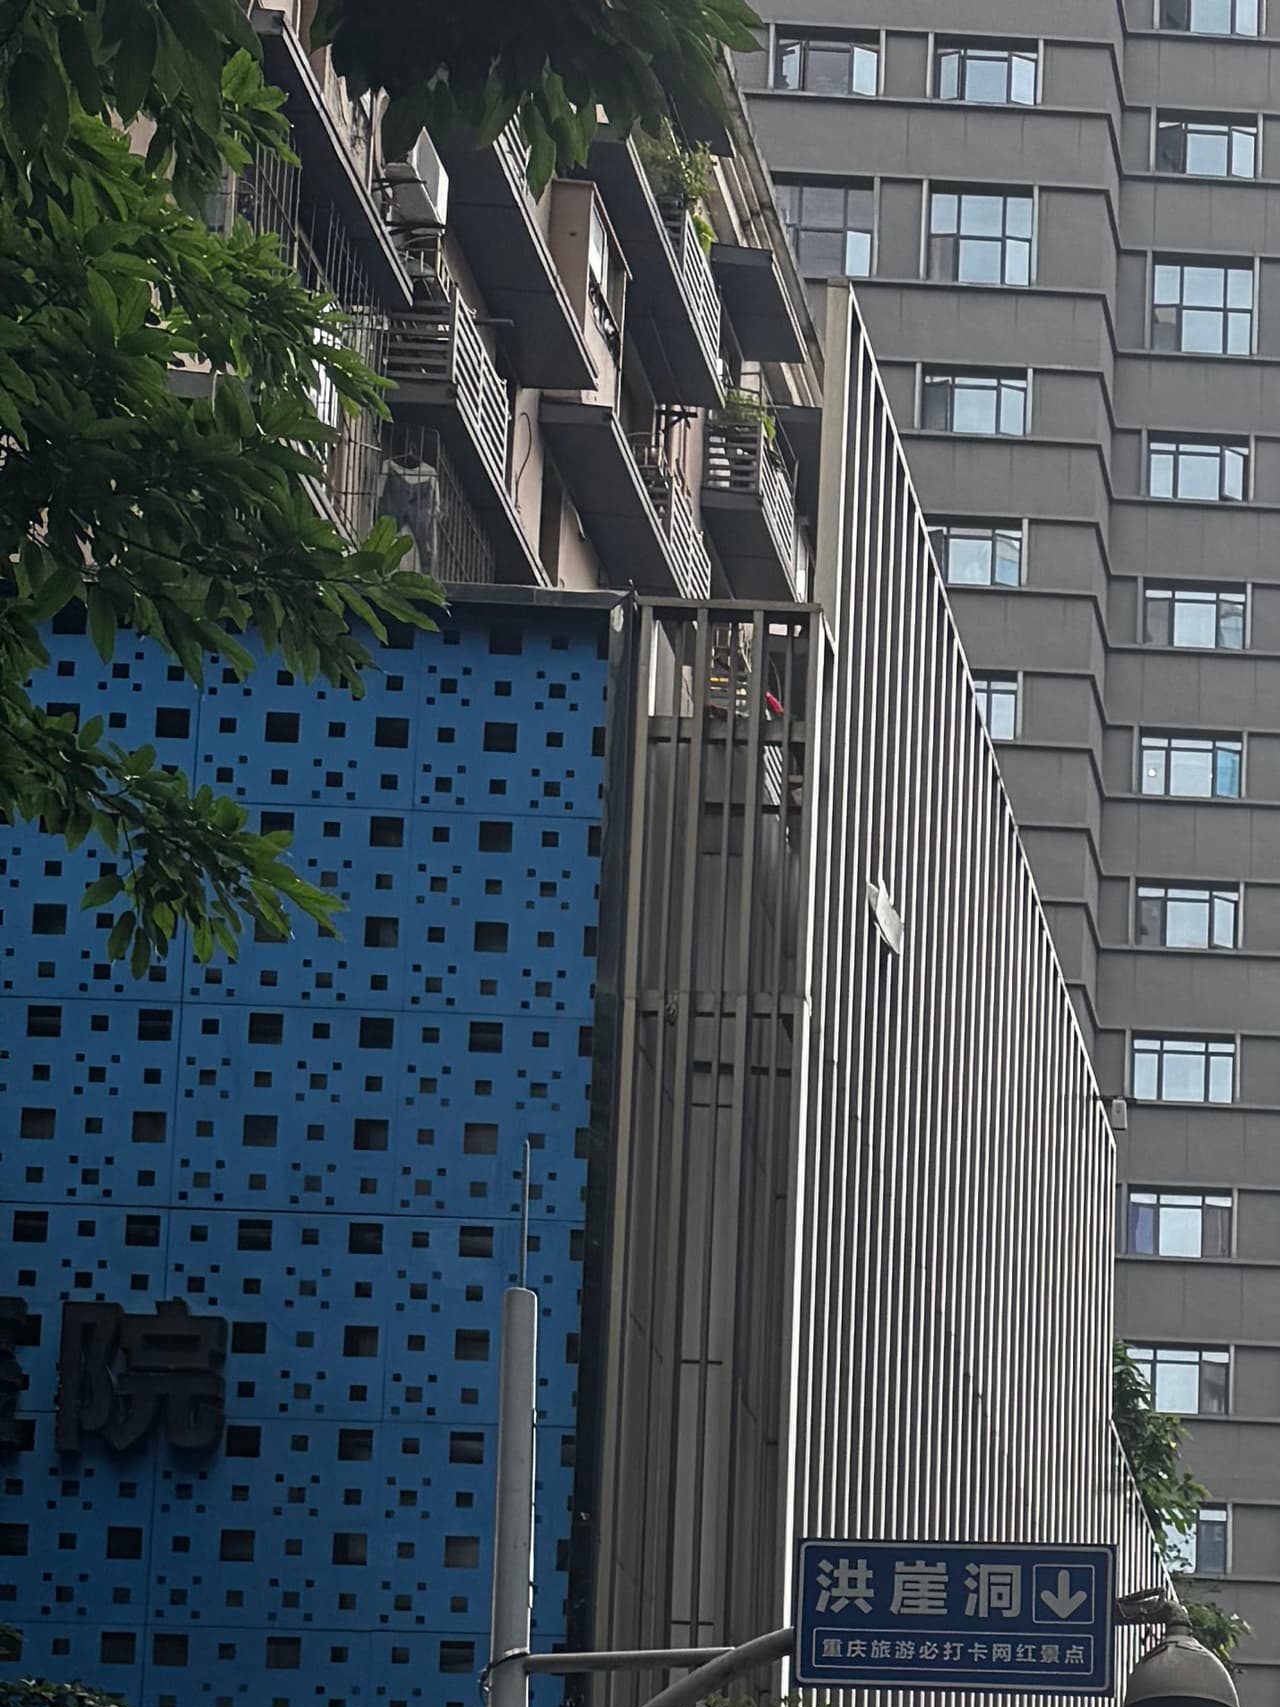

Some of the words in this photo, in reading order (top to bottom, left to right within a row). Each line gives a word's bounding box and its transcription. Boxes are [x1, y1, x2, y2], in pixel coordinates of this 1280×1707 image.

[815, 1558, 1022, 1618] 洪崖洞
[822, 1638, 1085, 1665] 重庆旅游必打卡网红景点
